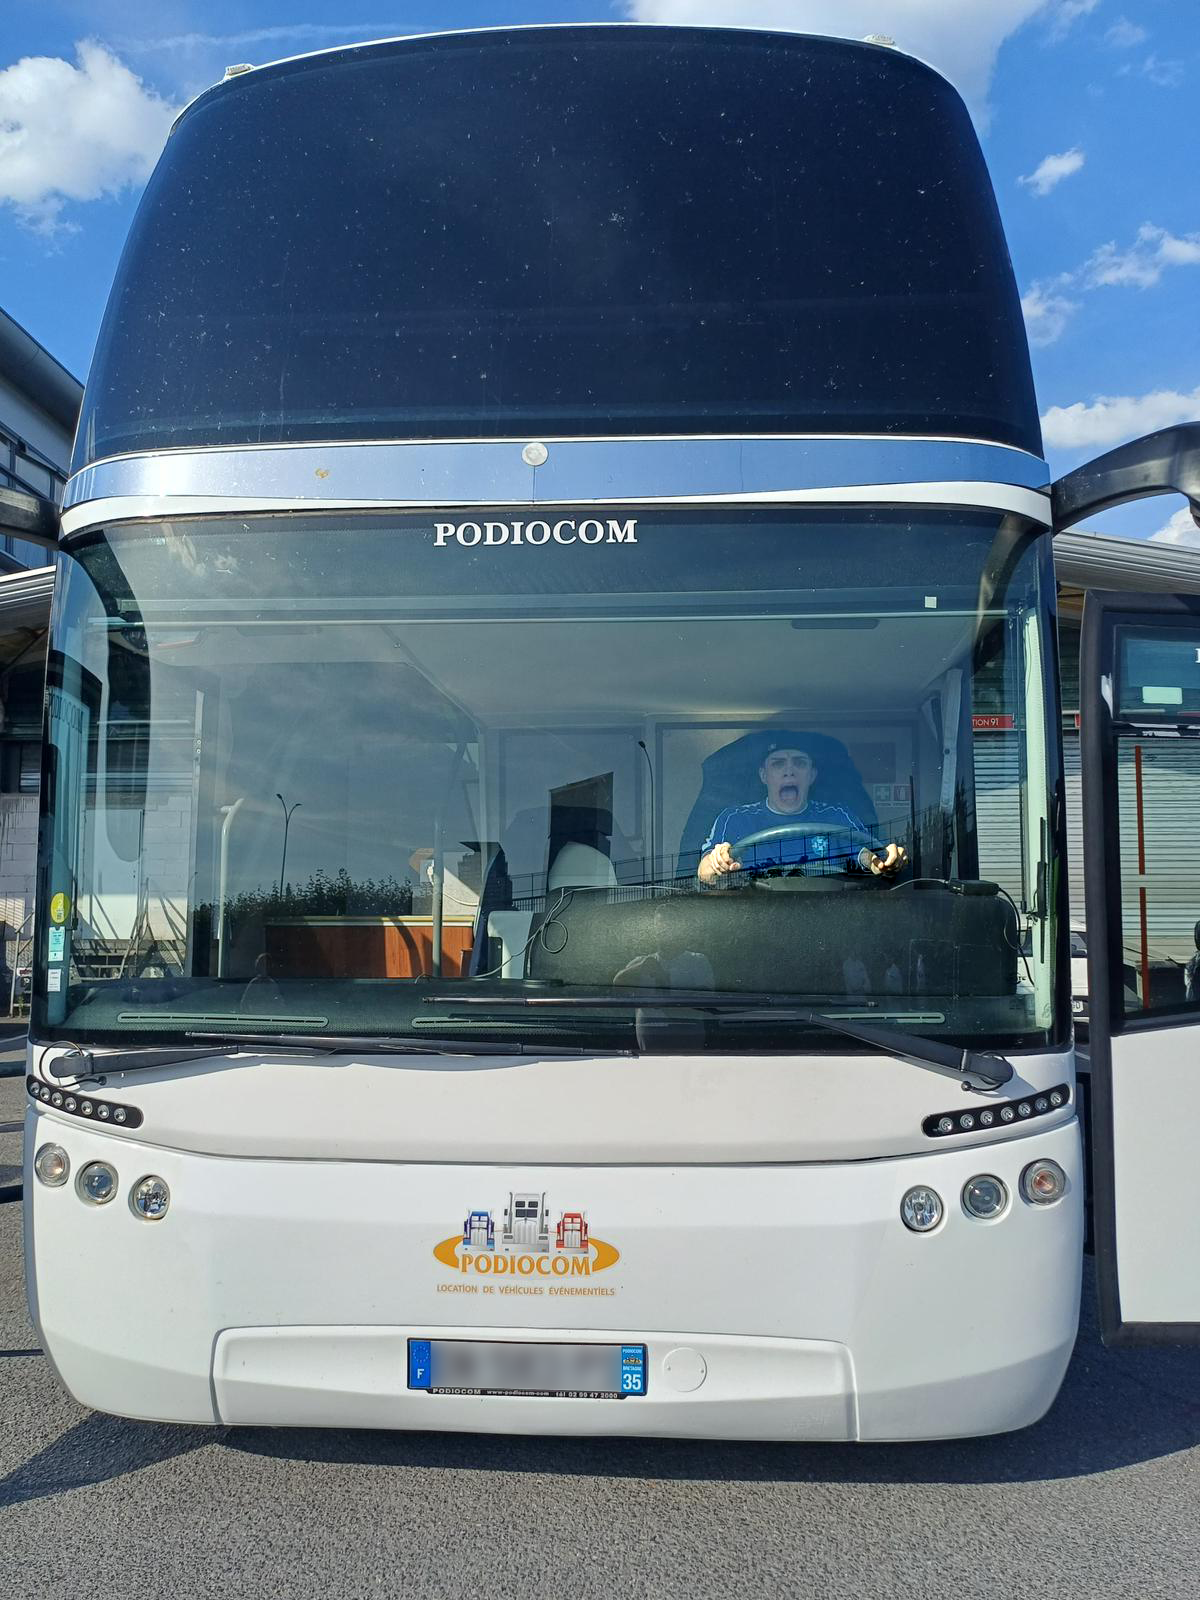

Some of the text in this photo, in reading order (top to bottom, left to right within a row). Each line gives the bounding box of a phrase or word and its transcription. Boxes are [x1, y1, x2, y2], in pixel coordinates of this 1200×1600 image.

[433, 519, 638, 546] PODIOCOM
[991, 718, 999, 726] 91
[461, 1254, 591, 1275] PODIOCOM
[437, 1284, 478, 1293] LOCATION
[483, 1285, 494, 1293] DE
[499, 1285, 544, 1295] VÉHICULES
[417, 1368, 425, 1379] F
[623, 1373, 641, 1391] 35
